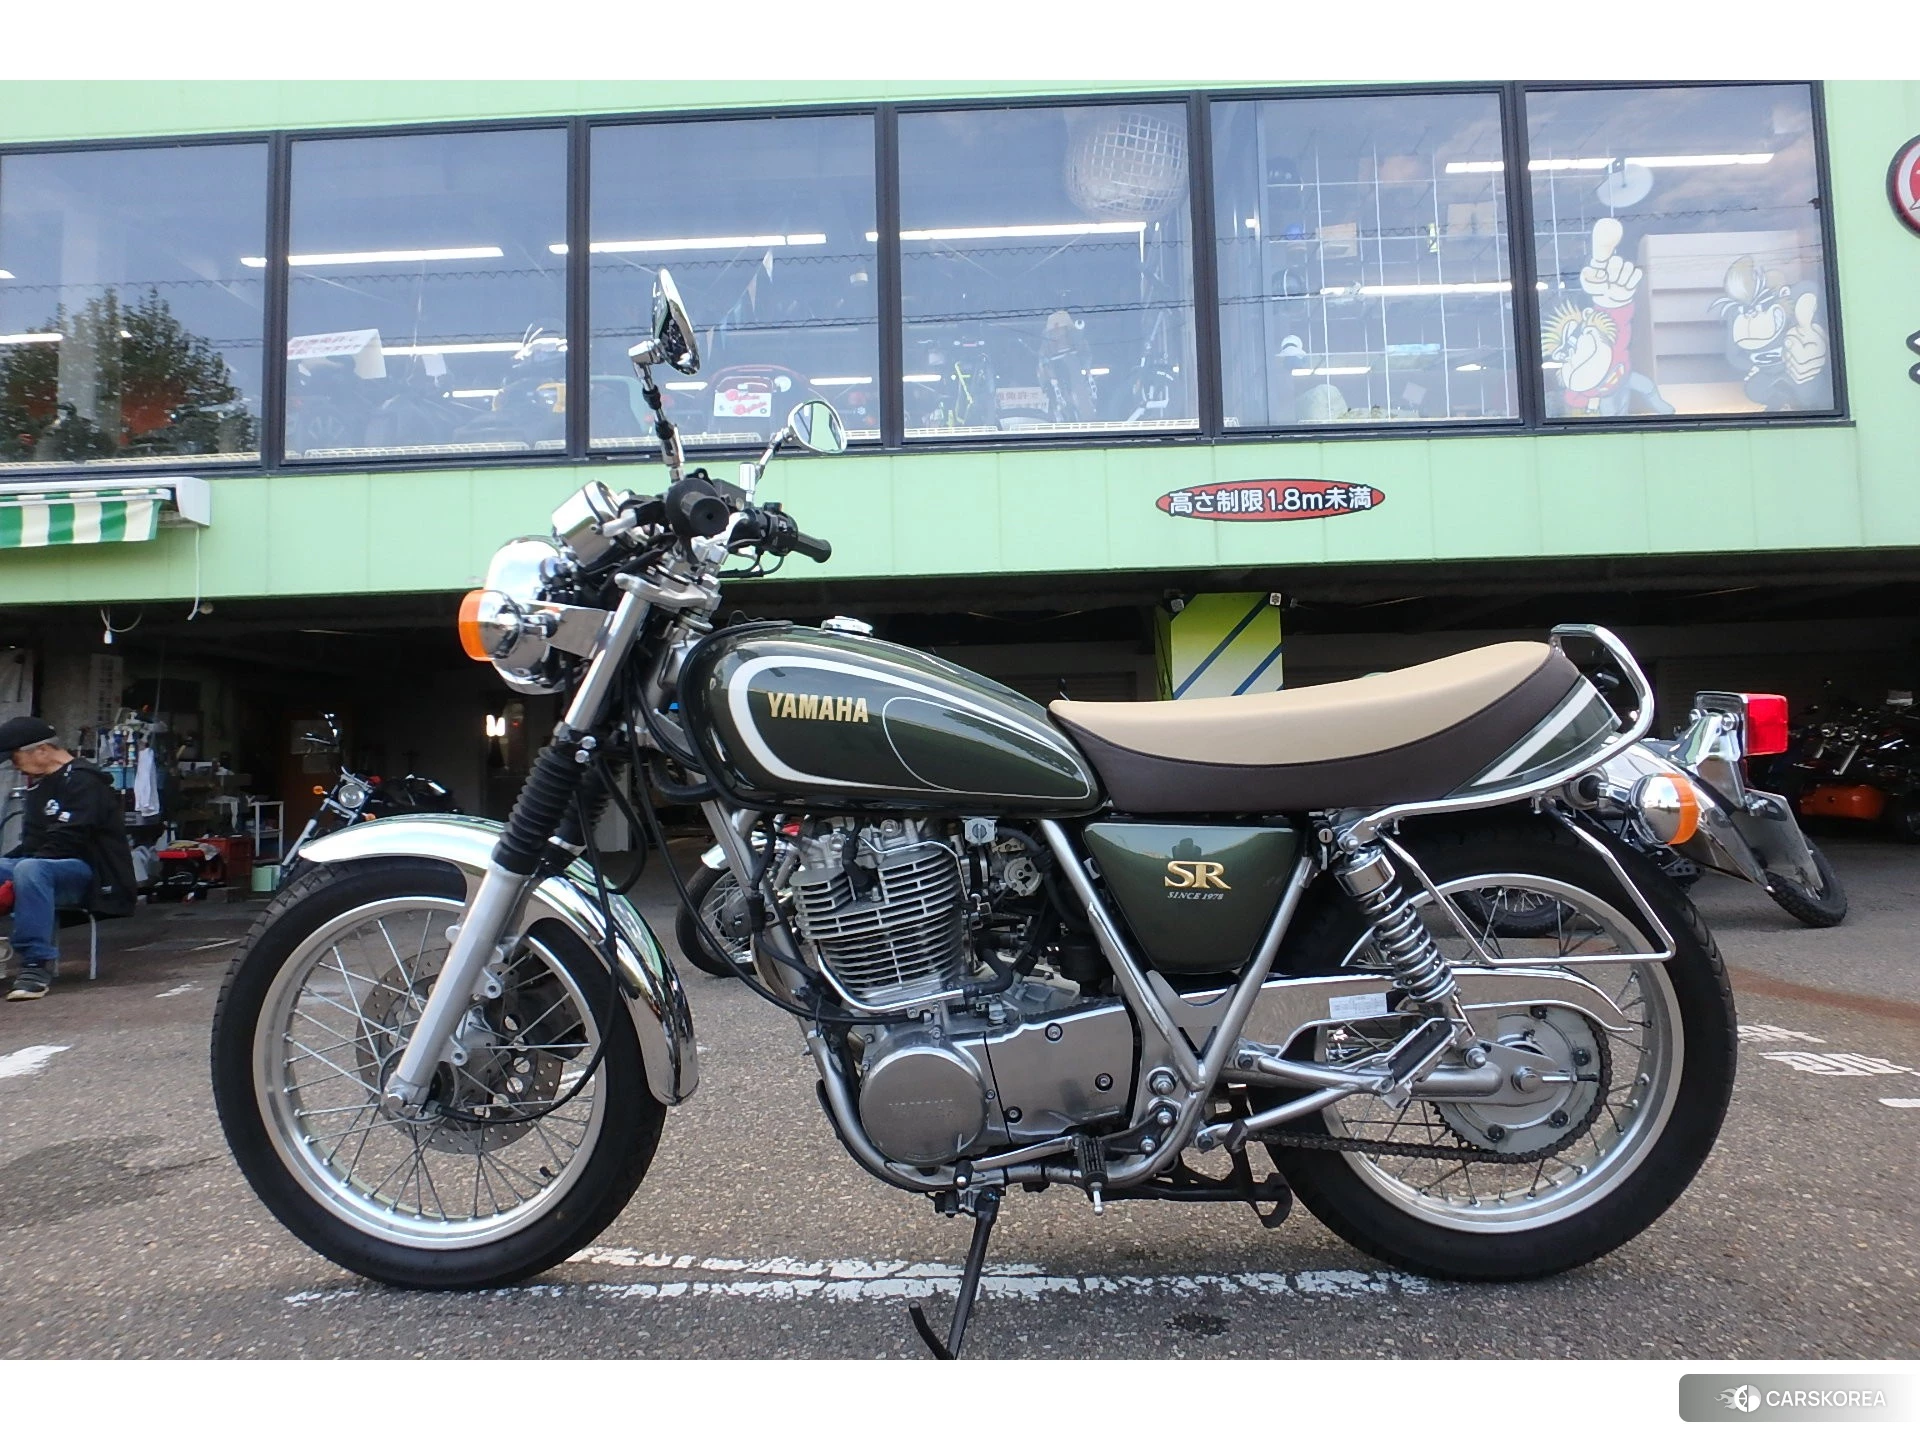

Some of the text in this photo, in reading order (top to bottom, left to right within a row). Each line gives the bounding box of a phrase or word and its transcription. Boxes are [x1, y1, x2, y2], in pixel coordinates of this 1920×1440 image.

[1169, 486, 1373, 515] 高さ制限1.8m未満
[767, 691, 869, 723] YAMAHA
[1164, 860, 1232, 890] SR
[1167, 891, 1225, 900] SINCE 1978
